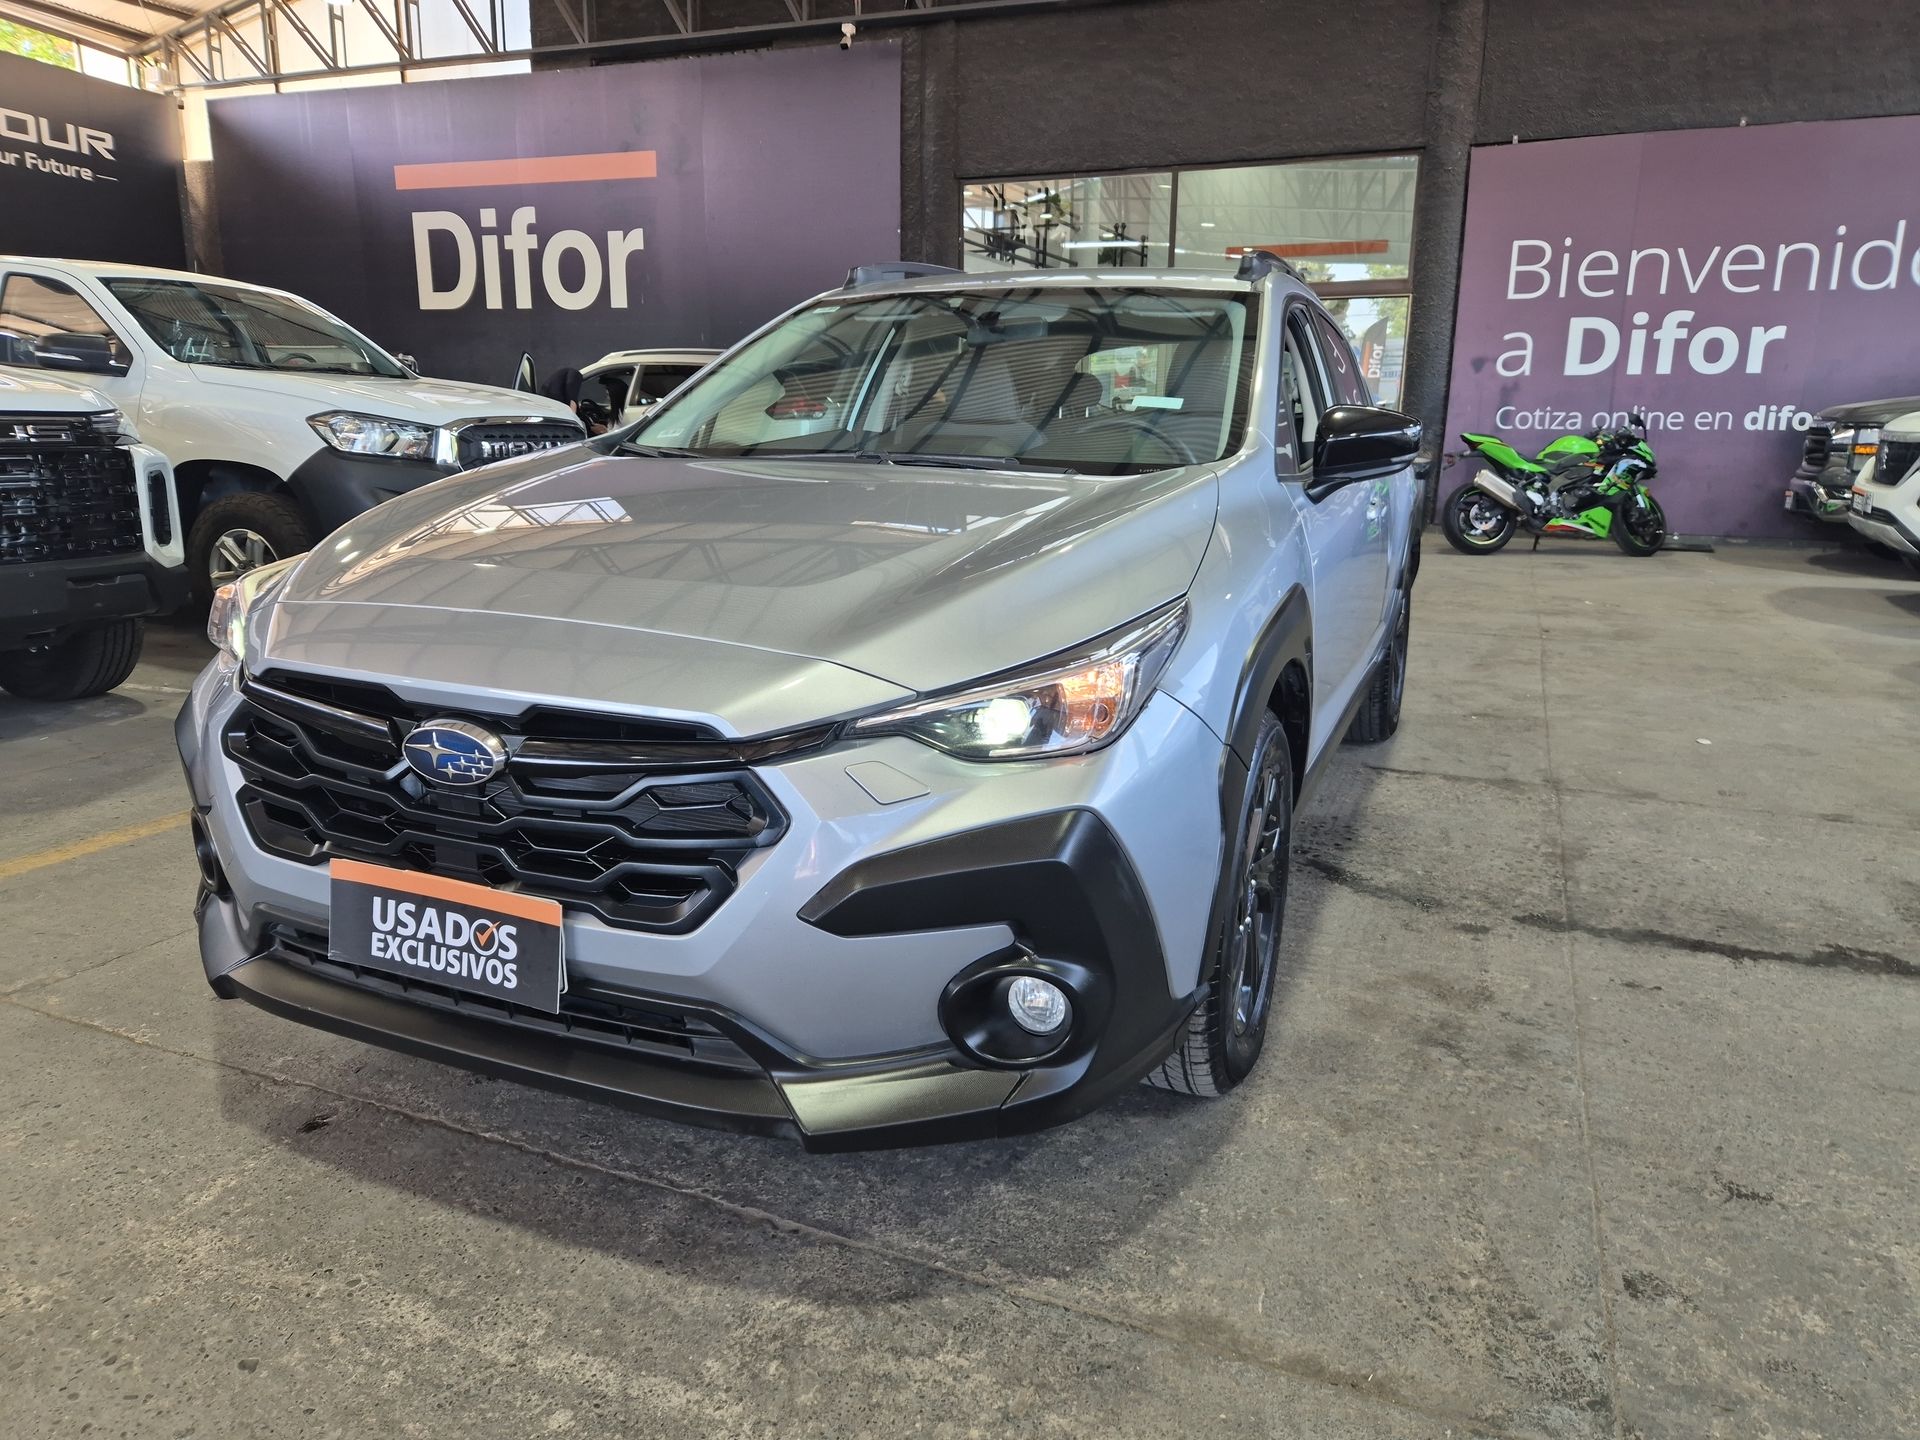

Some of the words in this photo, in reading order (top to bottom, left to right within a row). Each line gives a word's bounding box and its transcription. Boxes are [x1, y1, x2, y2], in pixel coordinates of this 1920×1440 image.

[24, 151, 95, 181] Future
[412, 206, 645, 310] Difor
[1506, 219, 1920, 300] Bienvenid
[1367, 343, 1384, 378] Difor
[1495, 330, 1535, 377] a
[1563, 310, 1788, 377] Difor
[1495, 405, 1583, 430] Cotiza
[1694, 408, 1733, 431] en
[481, 441, 568, 458] MAX
[372, 896, 518, 960] USADOS
[371, 932, 518, 989] EXCLUSIVOS
